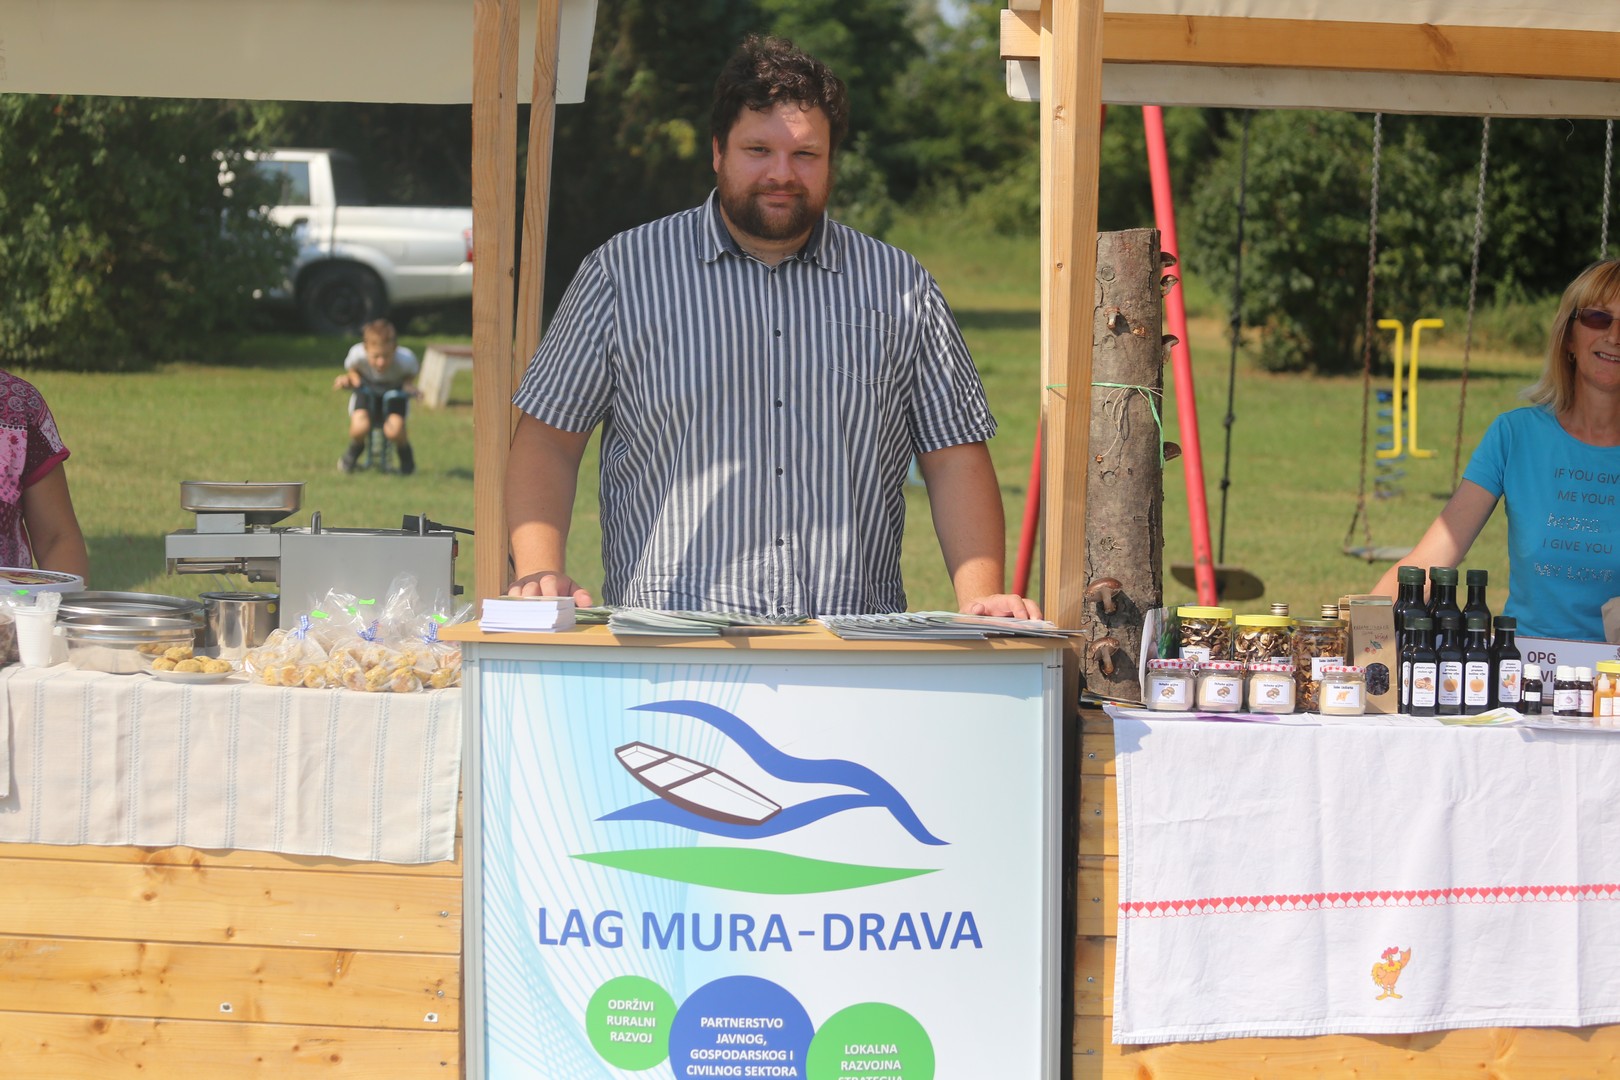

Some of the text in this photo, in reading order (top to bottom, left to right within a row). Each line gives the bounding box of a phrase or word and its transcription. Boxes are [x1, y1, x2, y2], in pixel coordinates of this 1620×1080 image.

[1554, 468, 1565, 479] IF
[1569, 468, 1594, 482] YOU
[1557, 490, 1615, 506] ME YOUR
[1551, 538, 1581, 552] GIVE
[1585, 541, 1613, 555] YOU
[1527, 650, 1557, 665] OPG
[538, 907, 984, 953] LAG MURA-DRAVA
[608, 998, 654, 1011] ODRŽIVI
[606, 1015, 656, 1027] RURALNI
[700, 1017, 784, 1029] PARTNERSTVO
[610, 1031, 653, 1043] RAZVOJ
[716, 1033, 767, 1046] JAVNOG,
[690, 1049, 794, 1061] GOSPODARSKOG I
[844, 1044, 898, 1055] LOKALNA
[686, 1065, 798, 1077] CIVILNOG SEKTORA
[840, 1060, 902, 1072] RAZVOJNA
